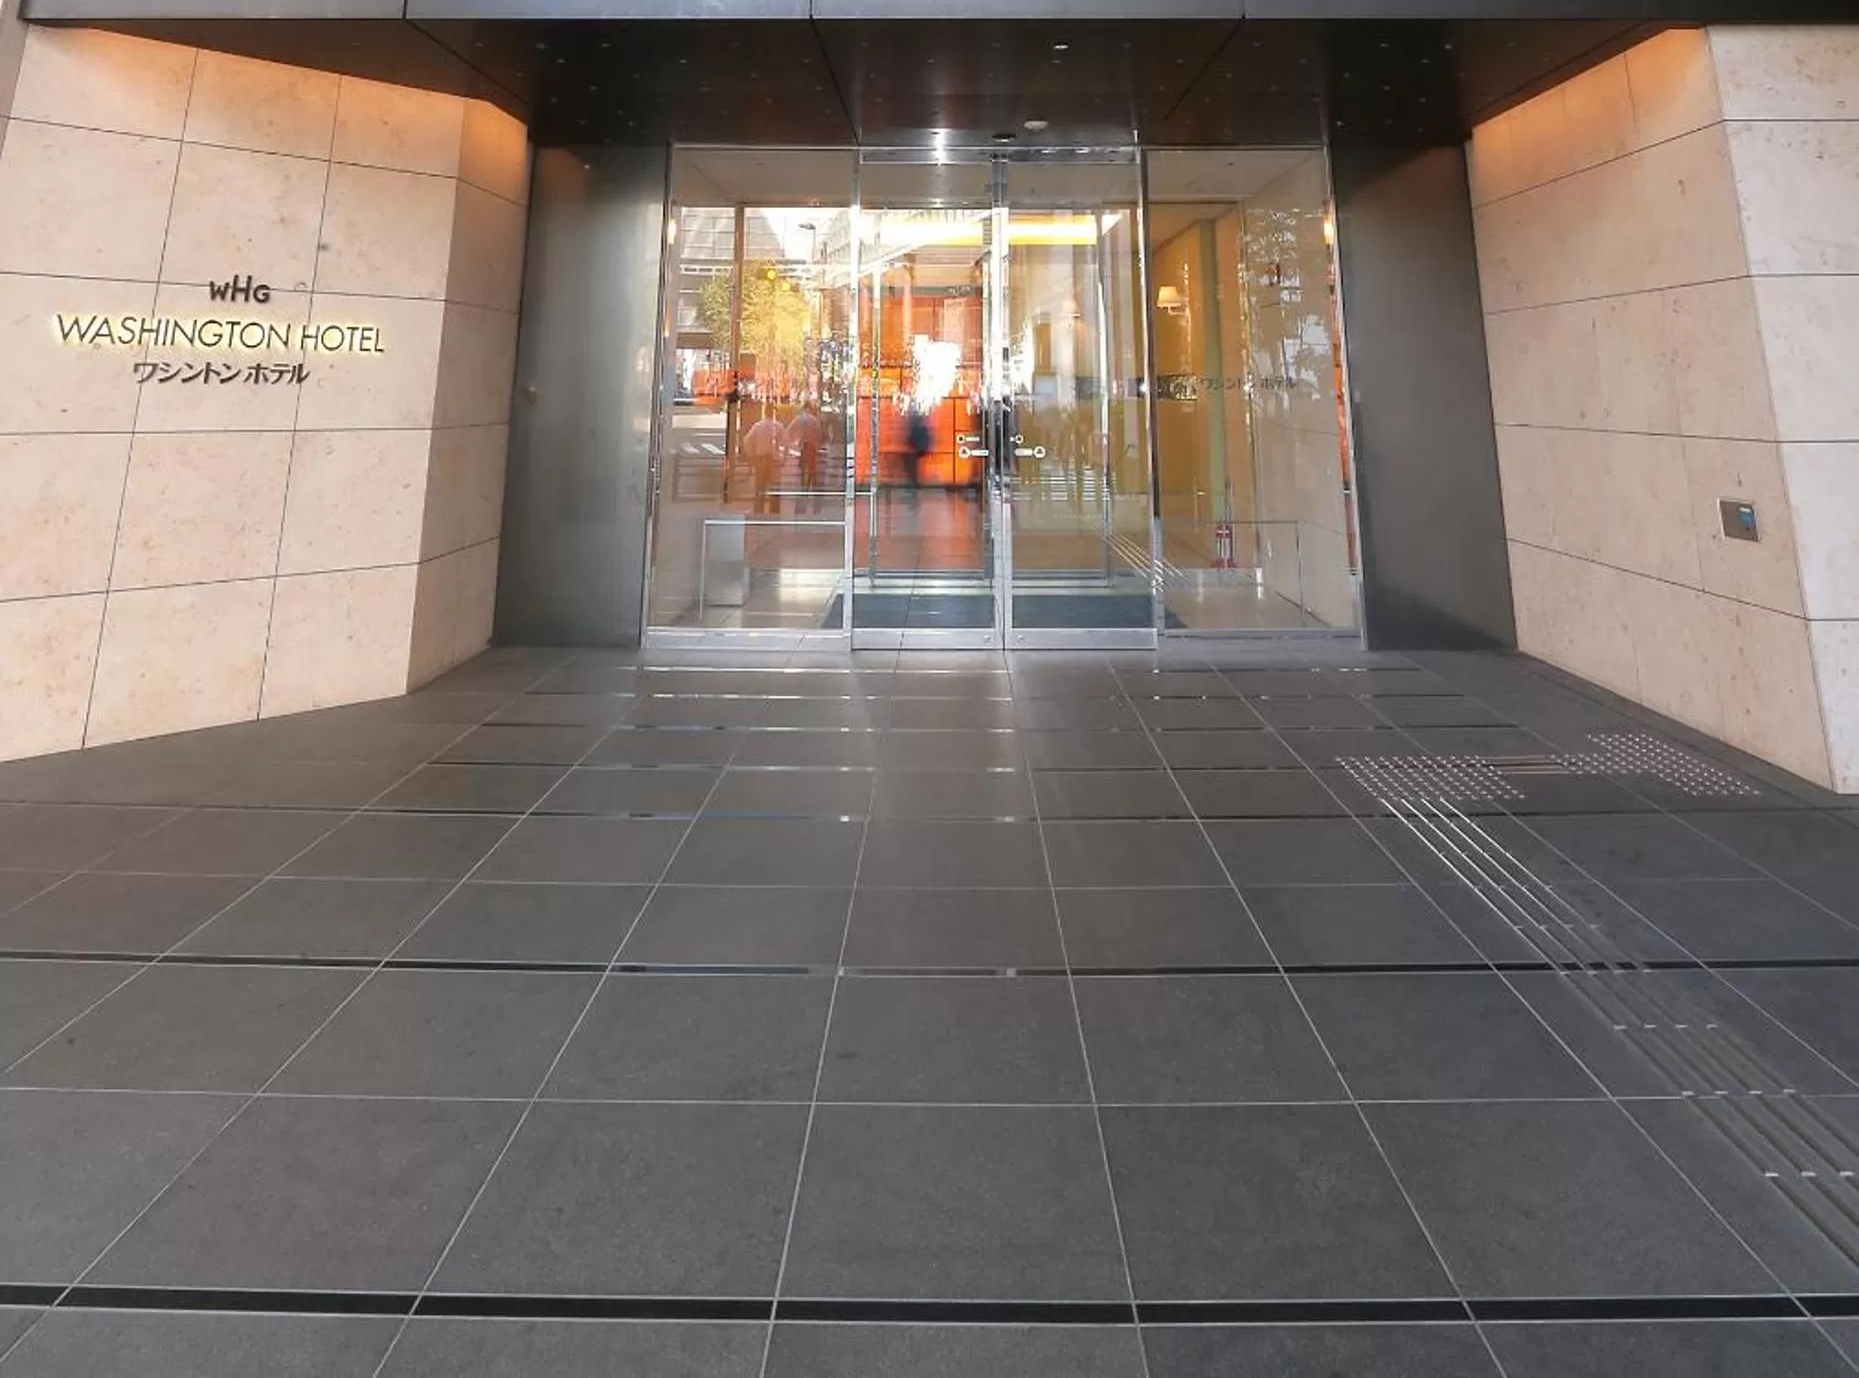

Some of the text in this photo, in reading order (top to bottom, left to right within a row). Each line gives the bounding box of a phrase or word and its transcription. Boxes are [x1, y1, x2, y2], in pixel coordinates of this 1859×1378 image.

[56, 313, 385, 353] WASHINGTON HOTEL
[133, 361, 311, 385] ワシントンホテル
